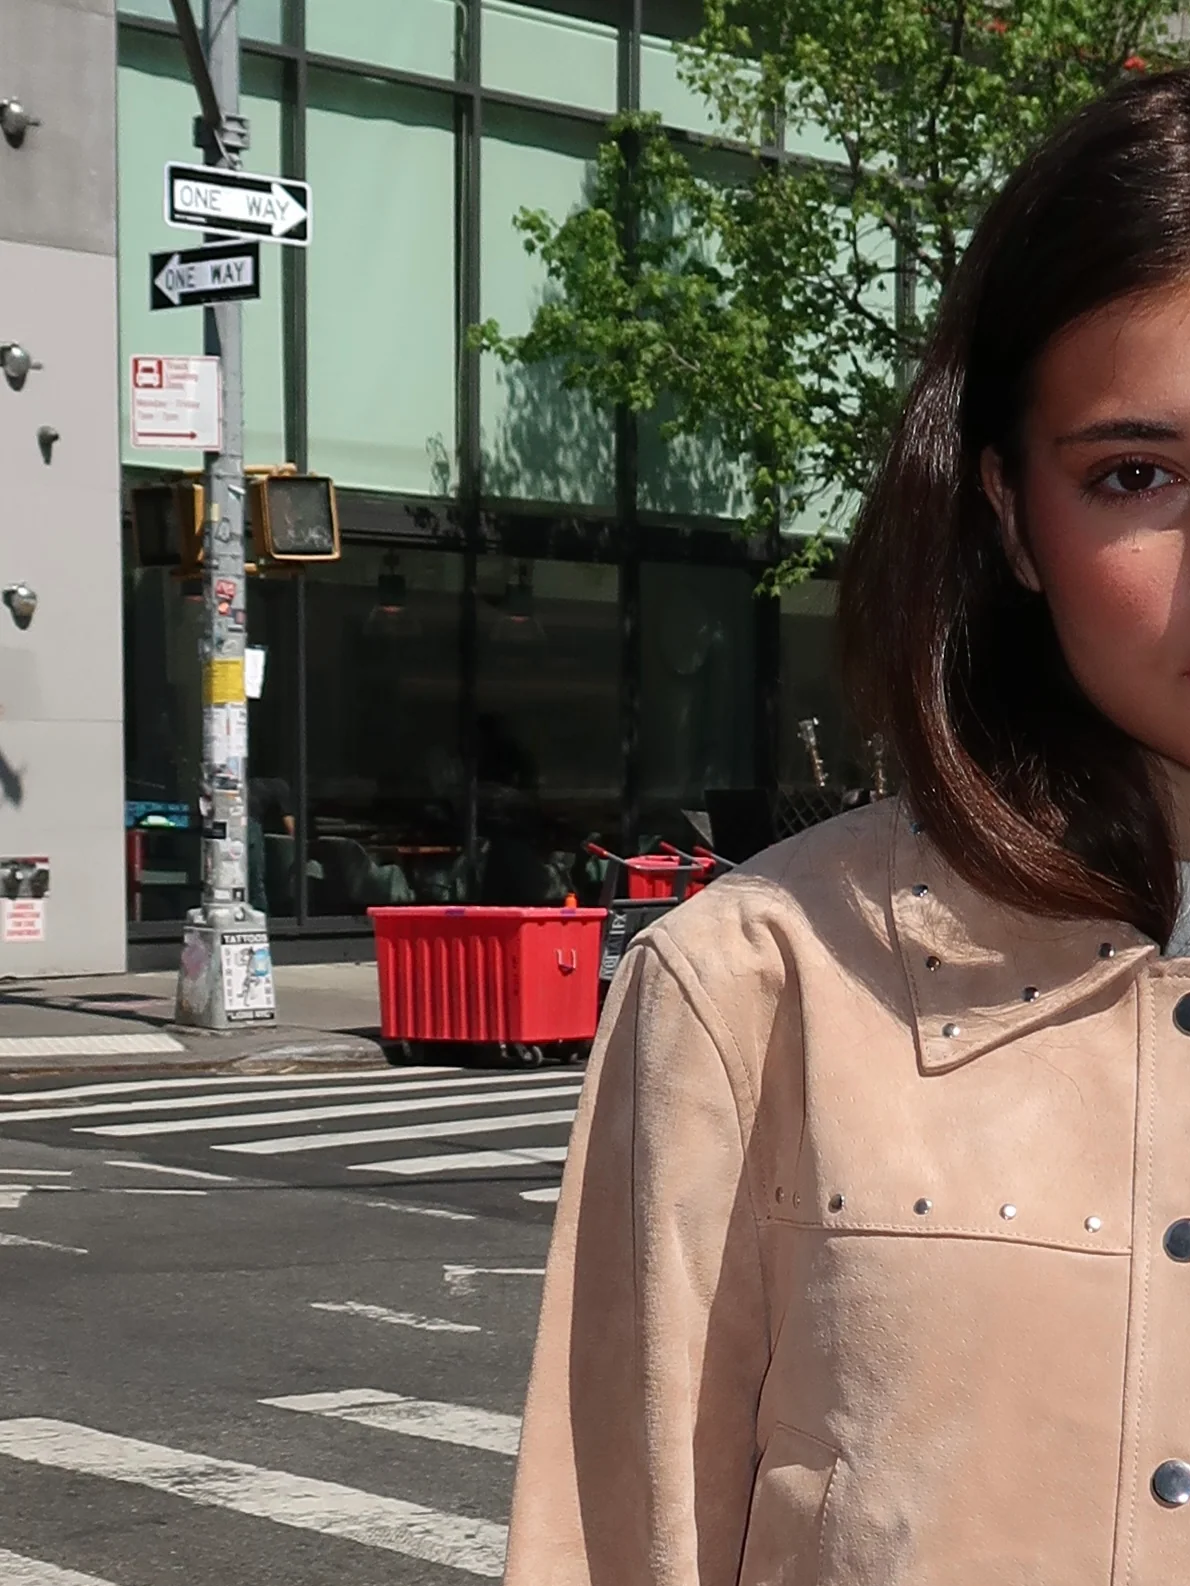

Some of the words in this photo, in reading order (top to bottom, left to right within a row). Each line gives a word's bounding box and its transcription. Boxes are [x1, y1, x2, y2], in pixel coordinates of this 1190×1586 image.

[180, 184, 222, 212] ONE
[245, 194, 290, 221] WAY
[165, 265, 196, 291] ONE
[209, 260, 244, 284] WAY
